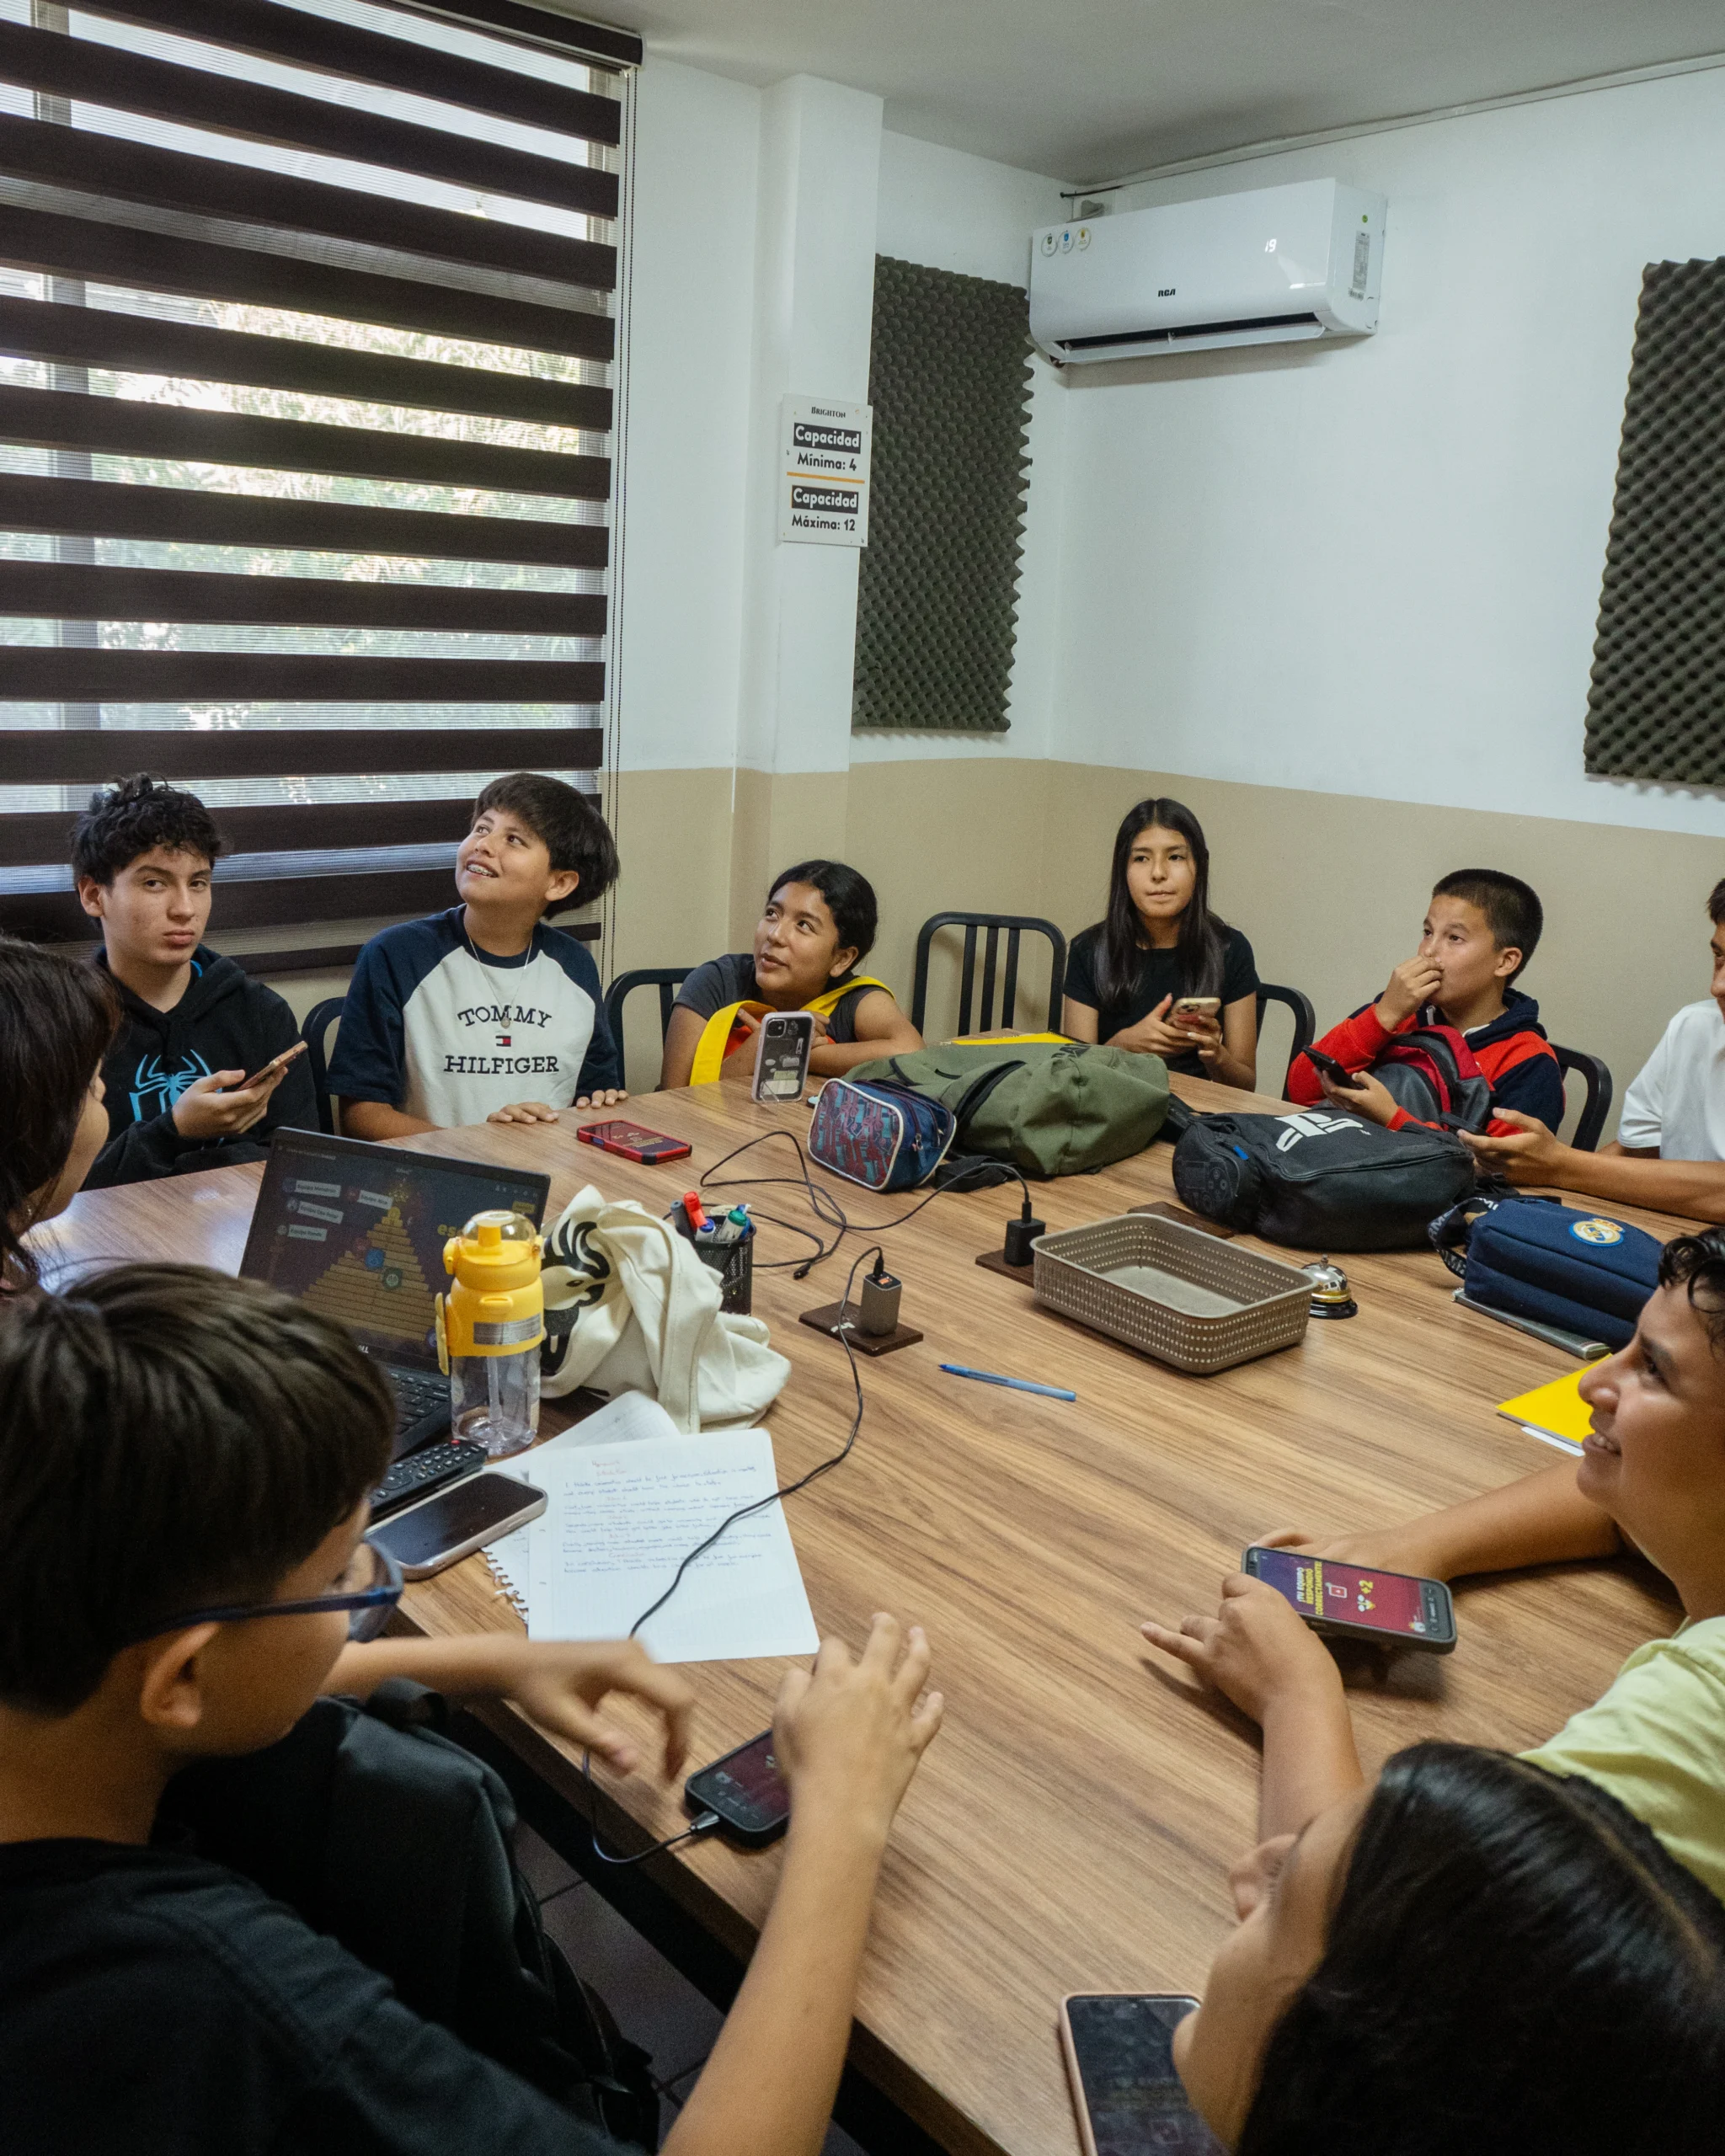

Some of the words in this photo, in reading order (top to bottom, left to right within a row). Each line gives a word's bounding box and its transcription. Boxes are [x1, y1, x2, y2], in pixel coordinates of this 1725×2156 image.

[1264, 238, 1277, 253] 19
[1157, 288, 1176, 297] RCA
[795, 425, 859, 447] Capacidad
[798, 452, 846, 470] Mínima:
[849, 458, 857, 471] 4
[793, 488, 857, 508] Capacidad
[791, 515, 841, 530] Máxima:
[843, 519, 856, 531] 12
[457, 1005, 552, 1028] TOMMY
[443, 1055, 559, 1074] HILFIGER
[1296, 1566, 1305, 1591] EQUIPO
